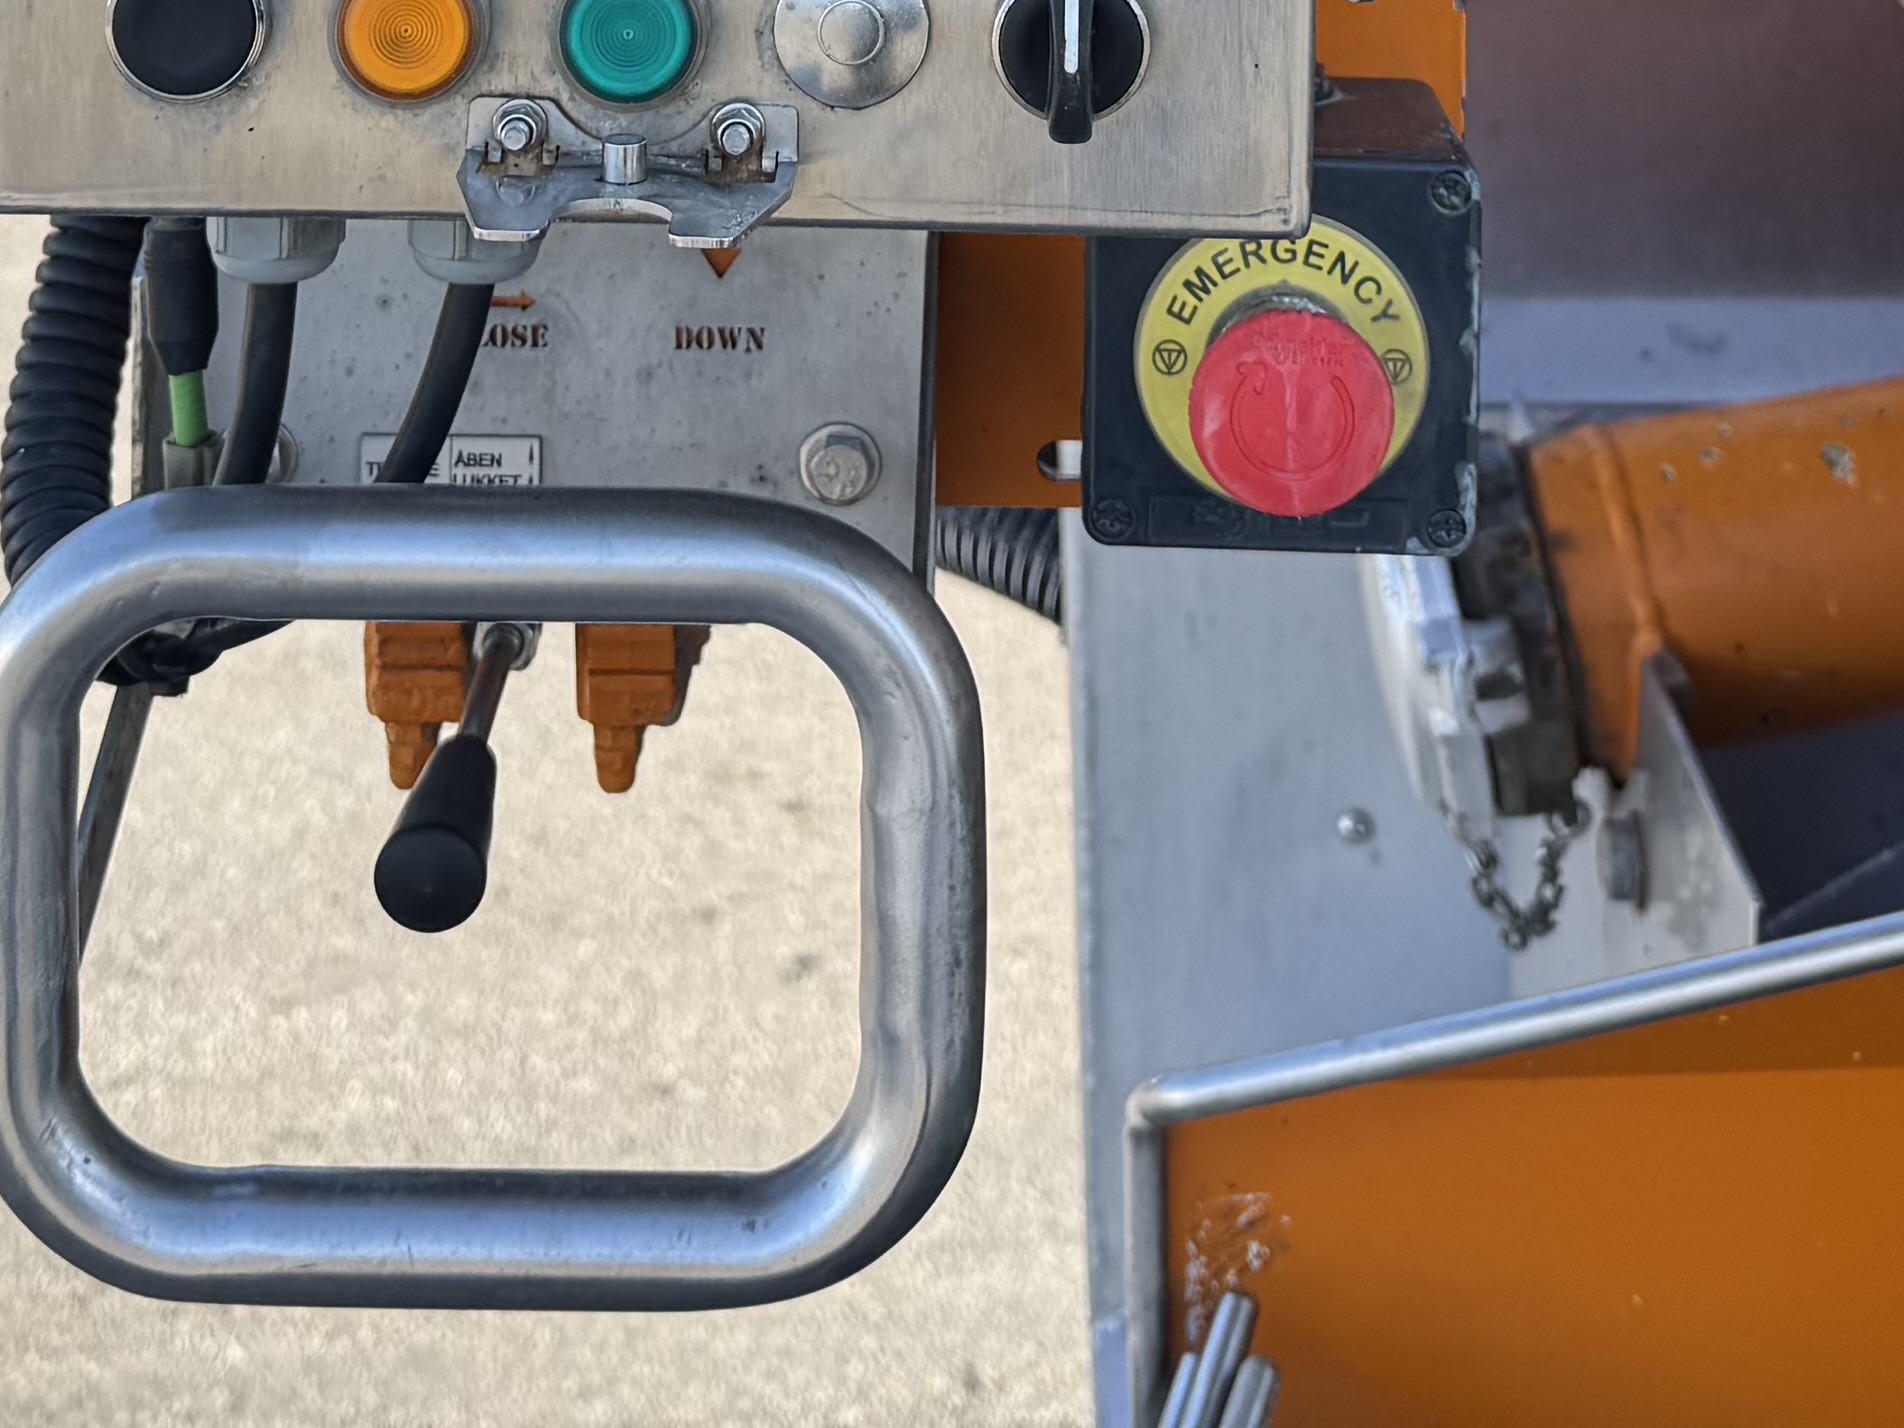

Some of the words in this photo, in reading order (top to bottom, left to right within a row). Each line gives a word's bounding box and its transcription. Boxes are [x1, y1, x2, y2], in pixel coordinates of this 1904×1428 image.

[1166, 239, 1401, 326] EMERGENCY
[482, 323, 550, 348] OSE
[674, 325, 766, 353] DOWN
[454, 449, 503, 467] ÅBEN
